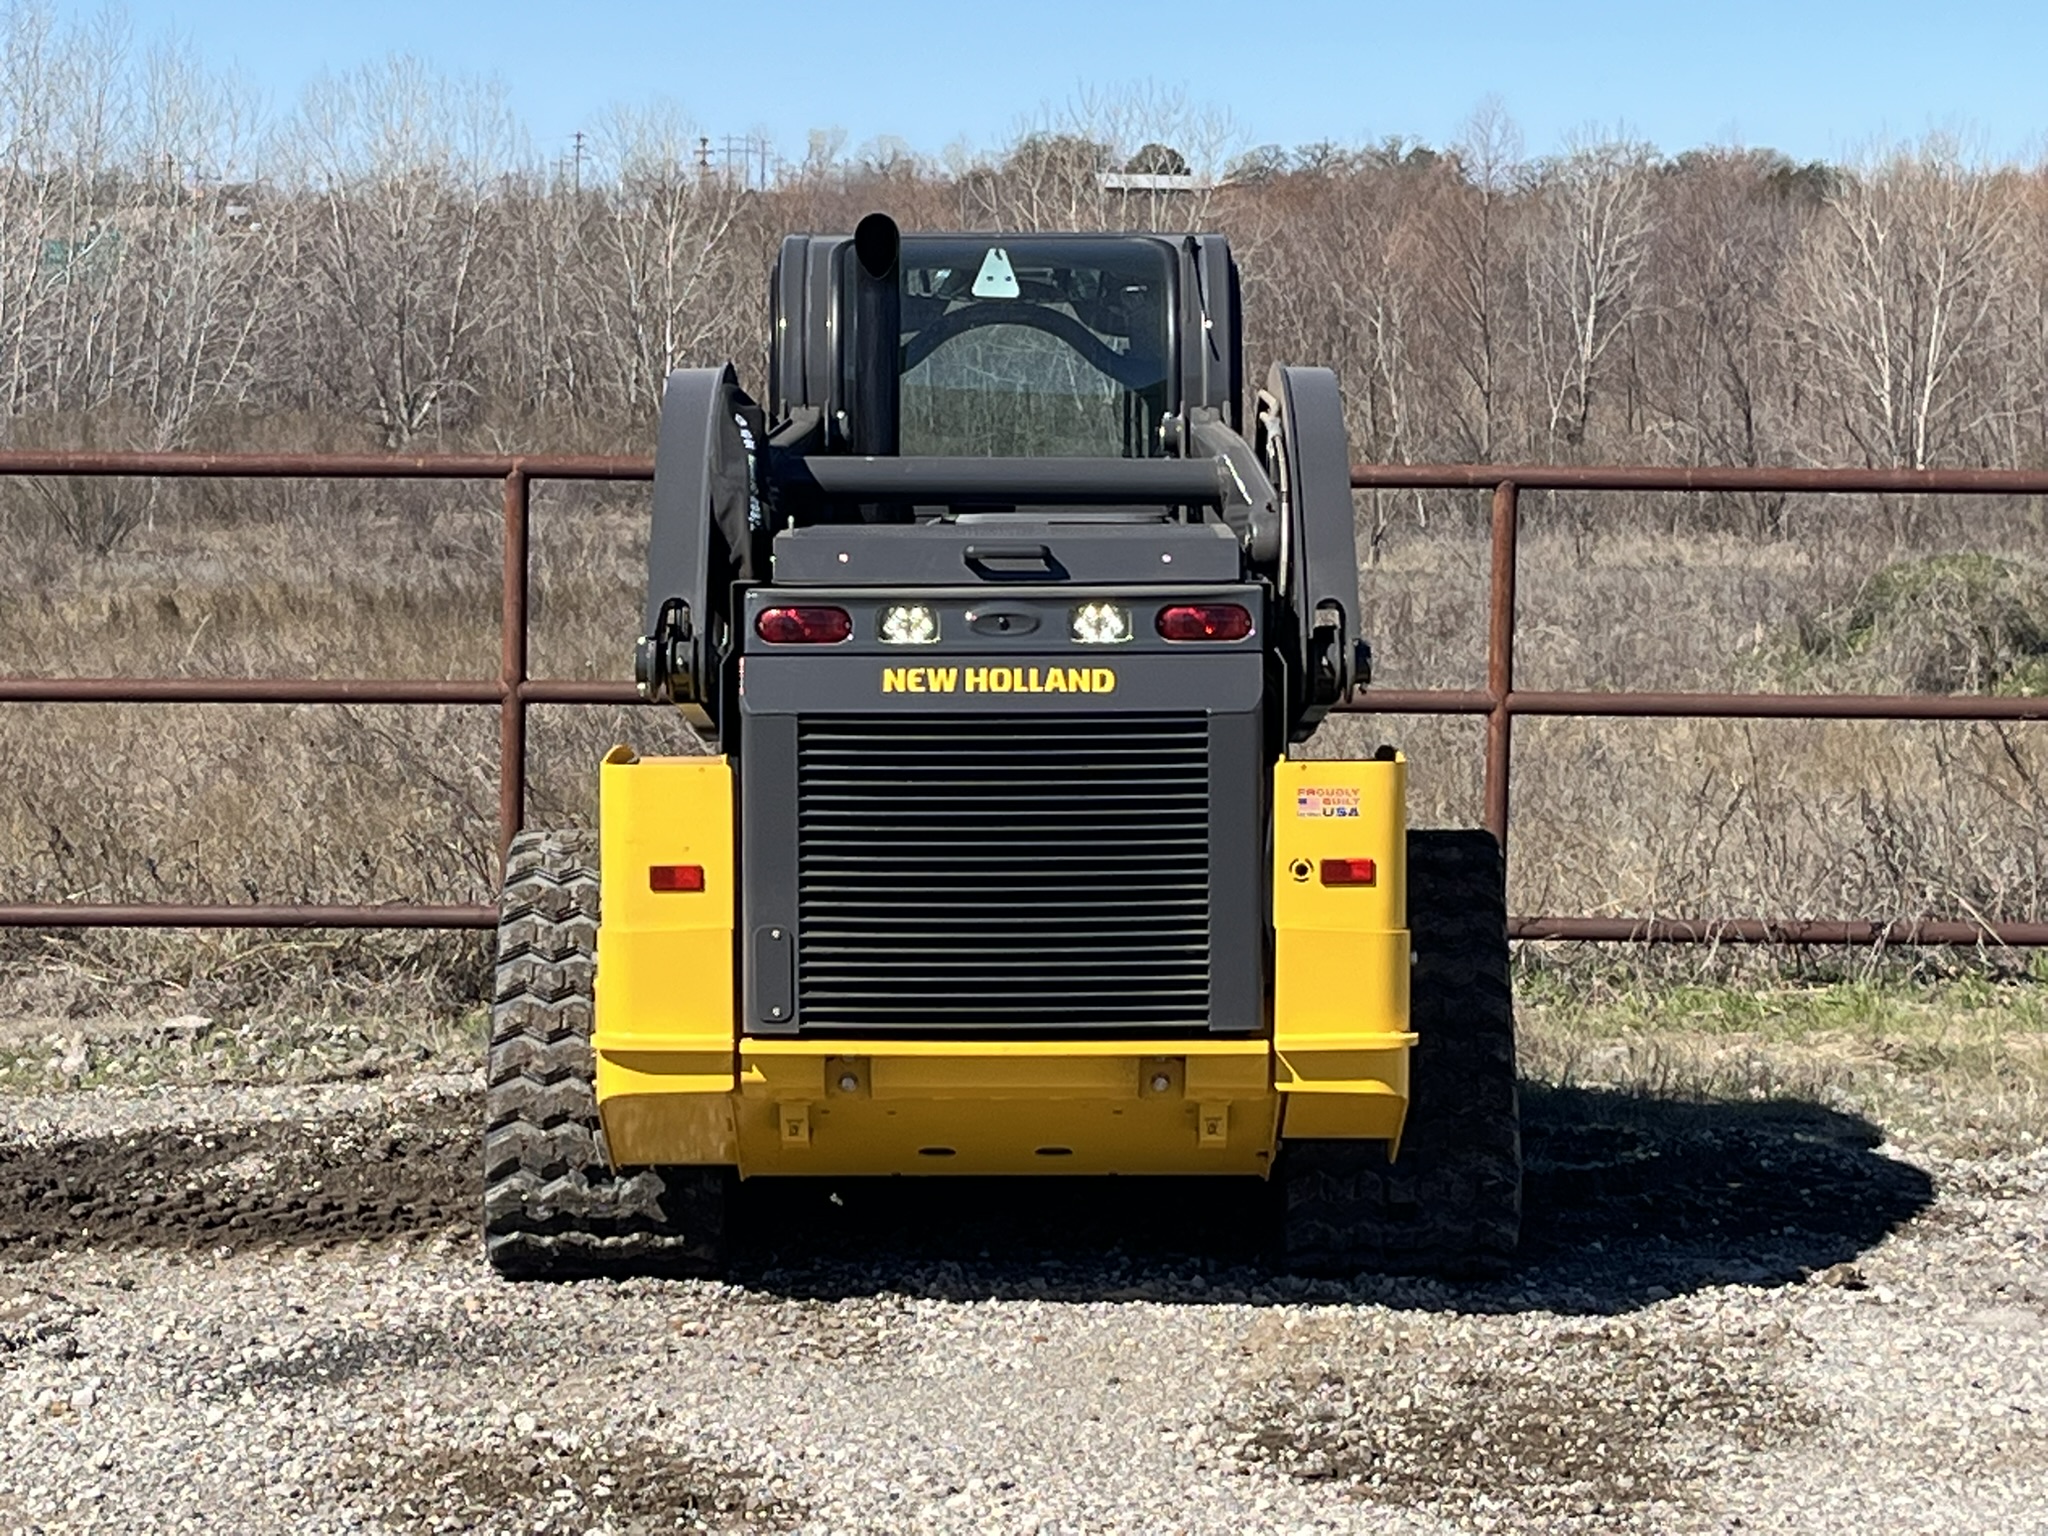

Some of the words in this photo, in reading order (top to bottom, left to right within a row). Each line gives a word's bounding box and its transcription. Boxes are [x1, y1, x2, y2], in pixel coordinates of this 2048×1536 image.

[883, 667, 958, 692] NEW
[964, 667, 1116, 692] HOLLAND
[1297, 788, 1360, 797] PROUDLY
[1322, 807, 1360, 817] USA
